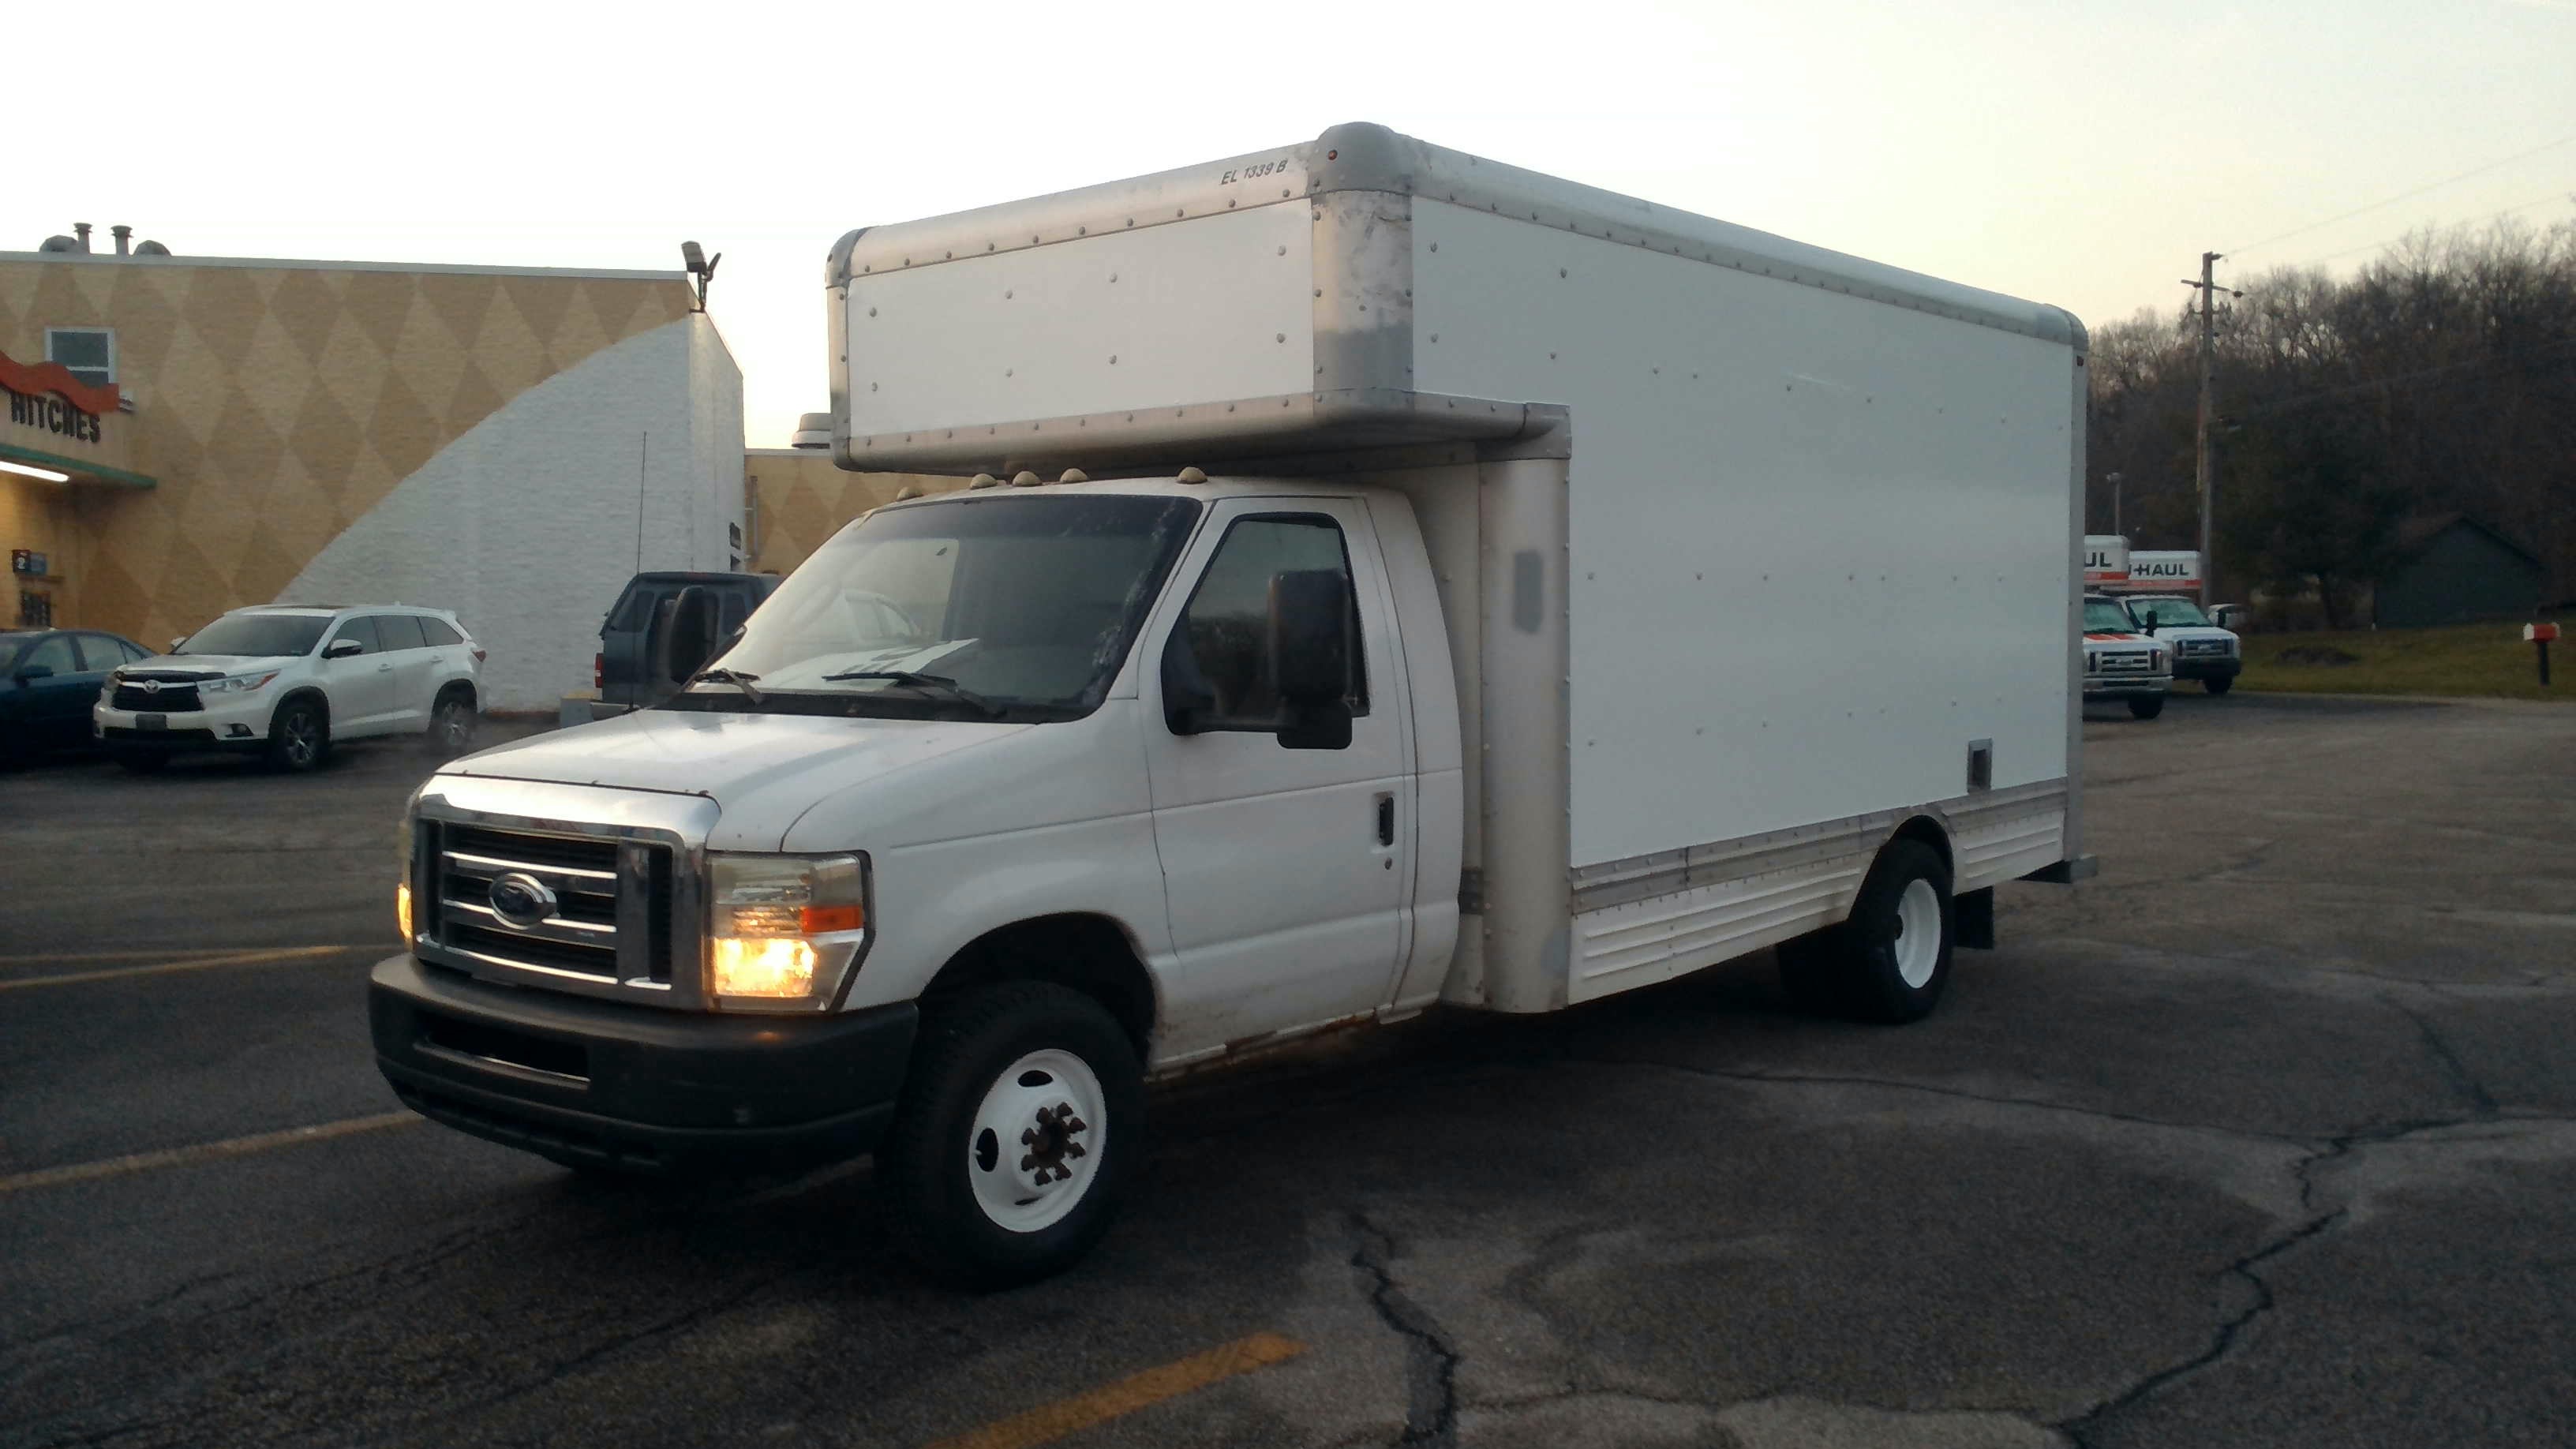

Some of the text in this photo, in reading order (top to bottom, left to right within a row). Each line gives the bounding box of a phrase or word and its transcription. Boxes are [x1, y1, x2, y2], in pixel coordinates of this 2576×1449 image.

[1221, 159, 1288, 185] EL 1339 B
[11, 392, 101, 444] HITCHES
